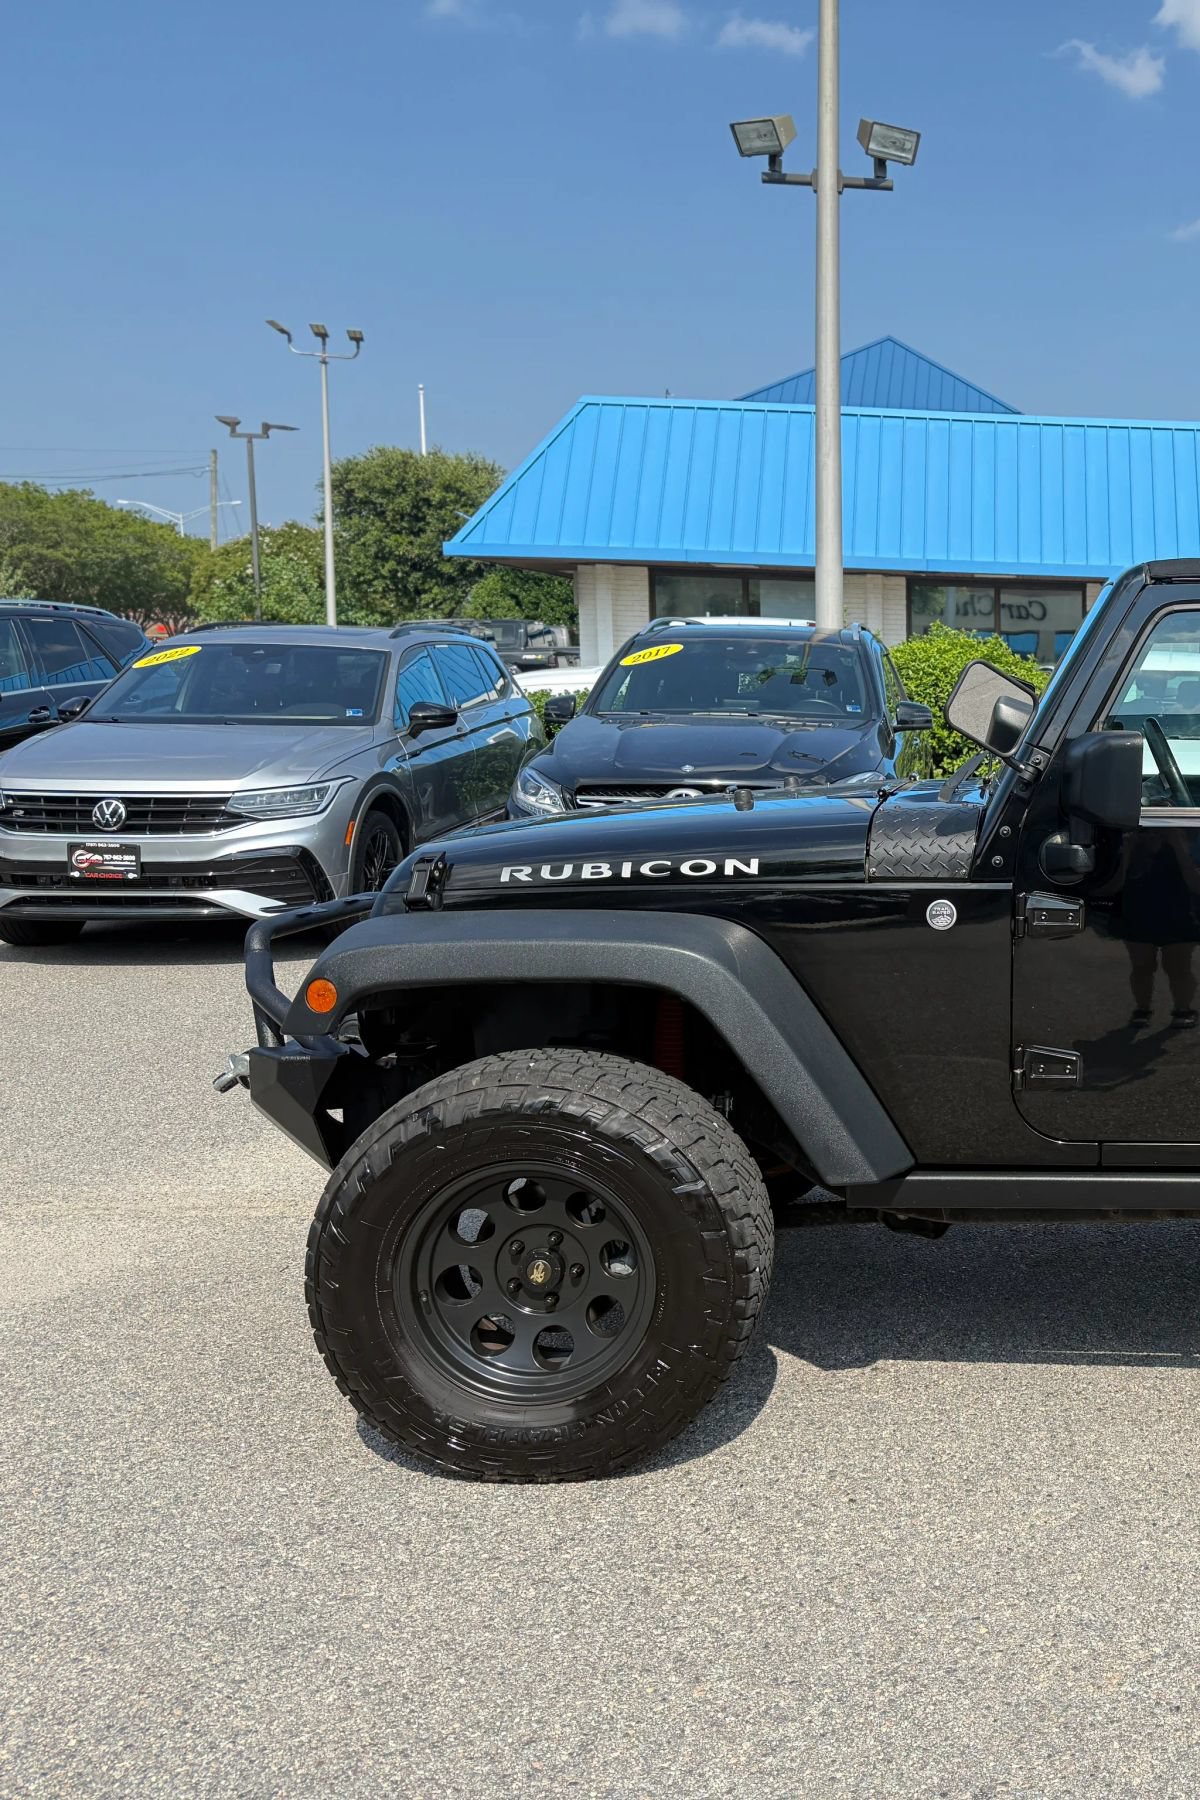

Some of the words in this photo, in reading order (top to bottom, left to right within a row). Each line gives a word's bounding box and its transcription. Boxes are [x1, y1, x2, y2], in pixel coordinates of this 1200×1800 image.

[144, 648, 191, 665] 2022
[632, 646, 672, 664] 2017
[500, 857, 760, 883] RUBICON
